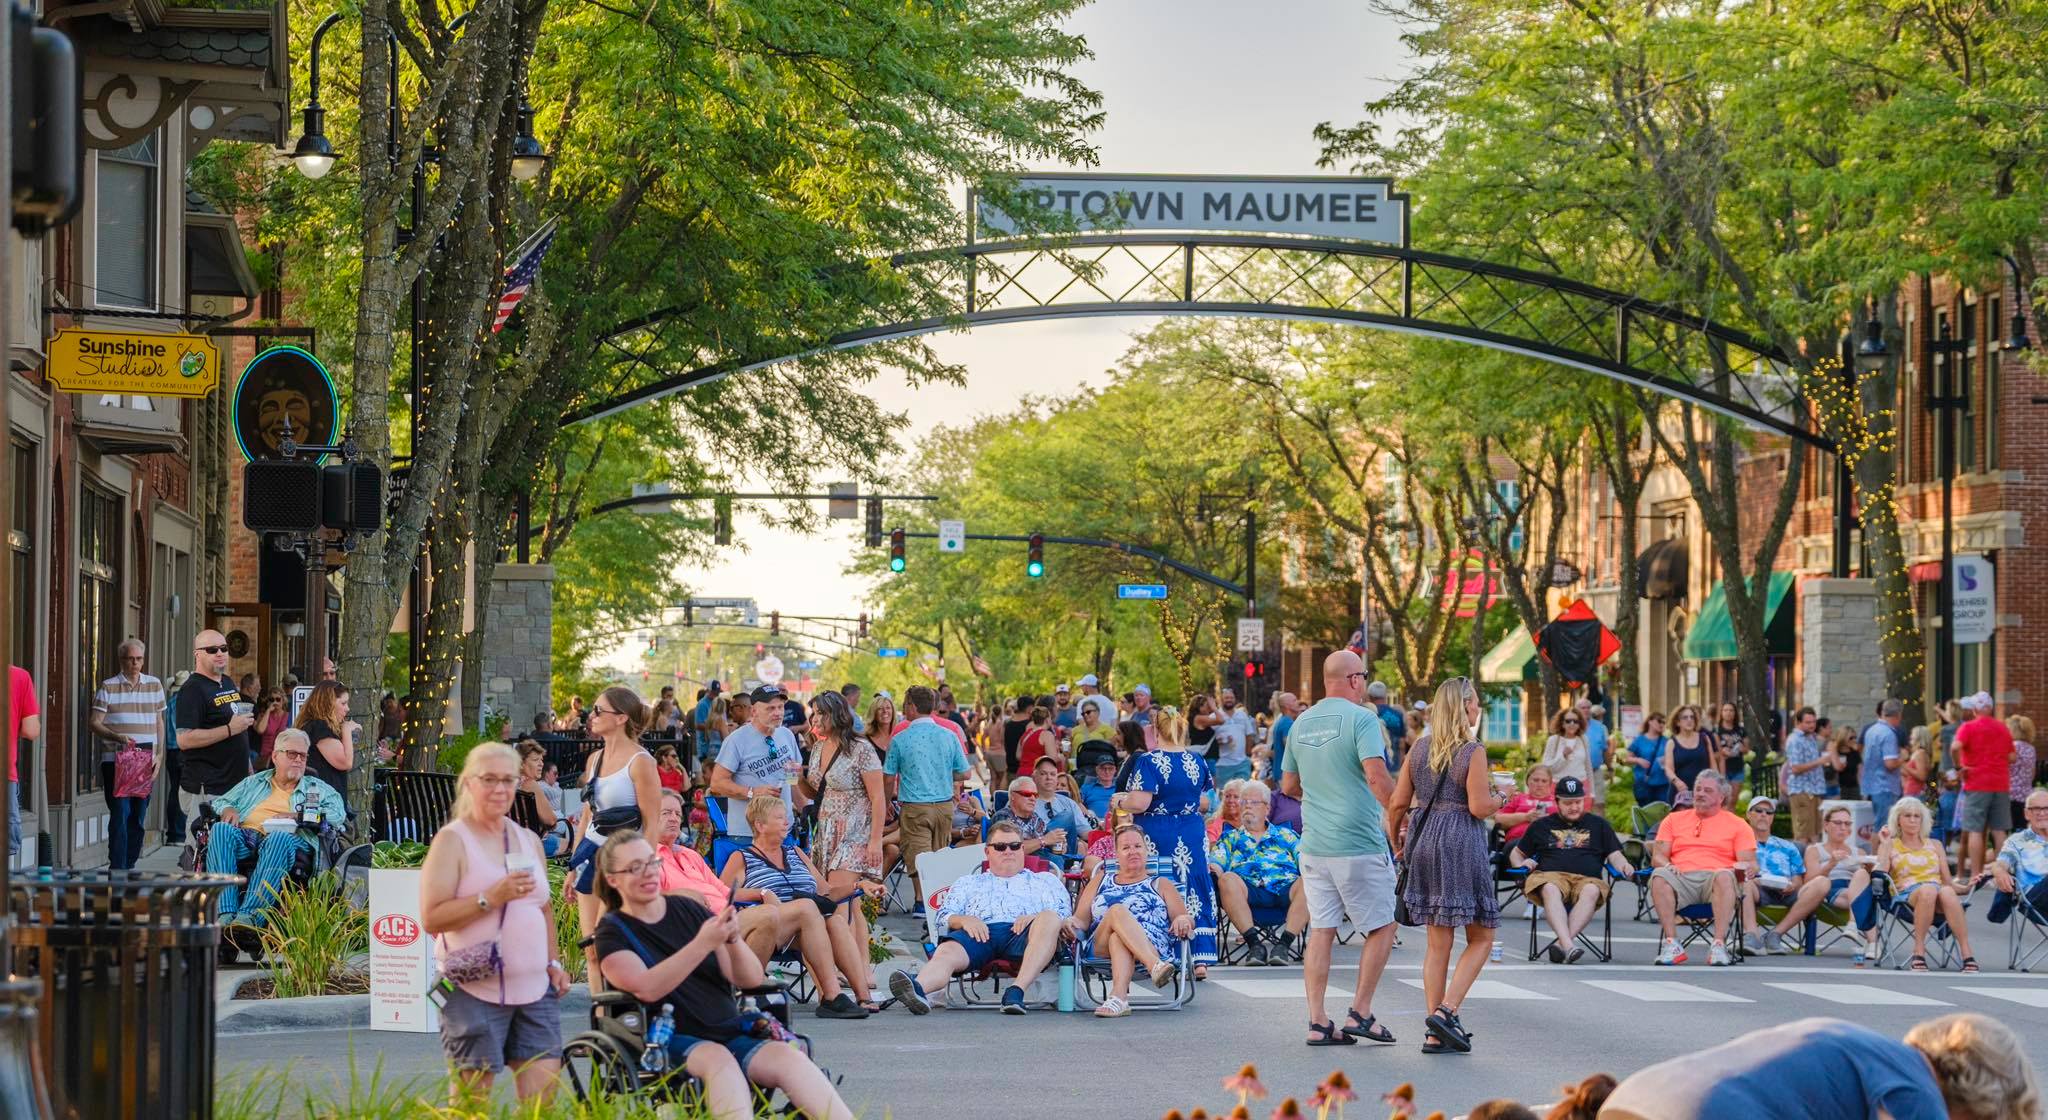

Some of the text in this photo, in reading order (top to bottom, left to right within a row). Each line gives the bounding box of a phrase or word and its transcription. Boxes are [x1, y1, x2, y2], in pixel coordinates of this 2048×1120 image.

[1010, 190, 1377, 223] PTOWN MAUMEE
[79, 337, 166, 357] Sunshine
[75, 351, 169, 377] Studios
[61, 378, 103, 386] CREATING
[150, 382, 204, 390] COMMUNITY
[1954, 609, 1986, 619] GROUP
[1241, 635, 1261, 647] 25
[214, 692, 241, 706] STEELER
[755, 769, 766, 779] TO
[378, 917, 415, 937] ACE
